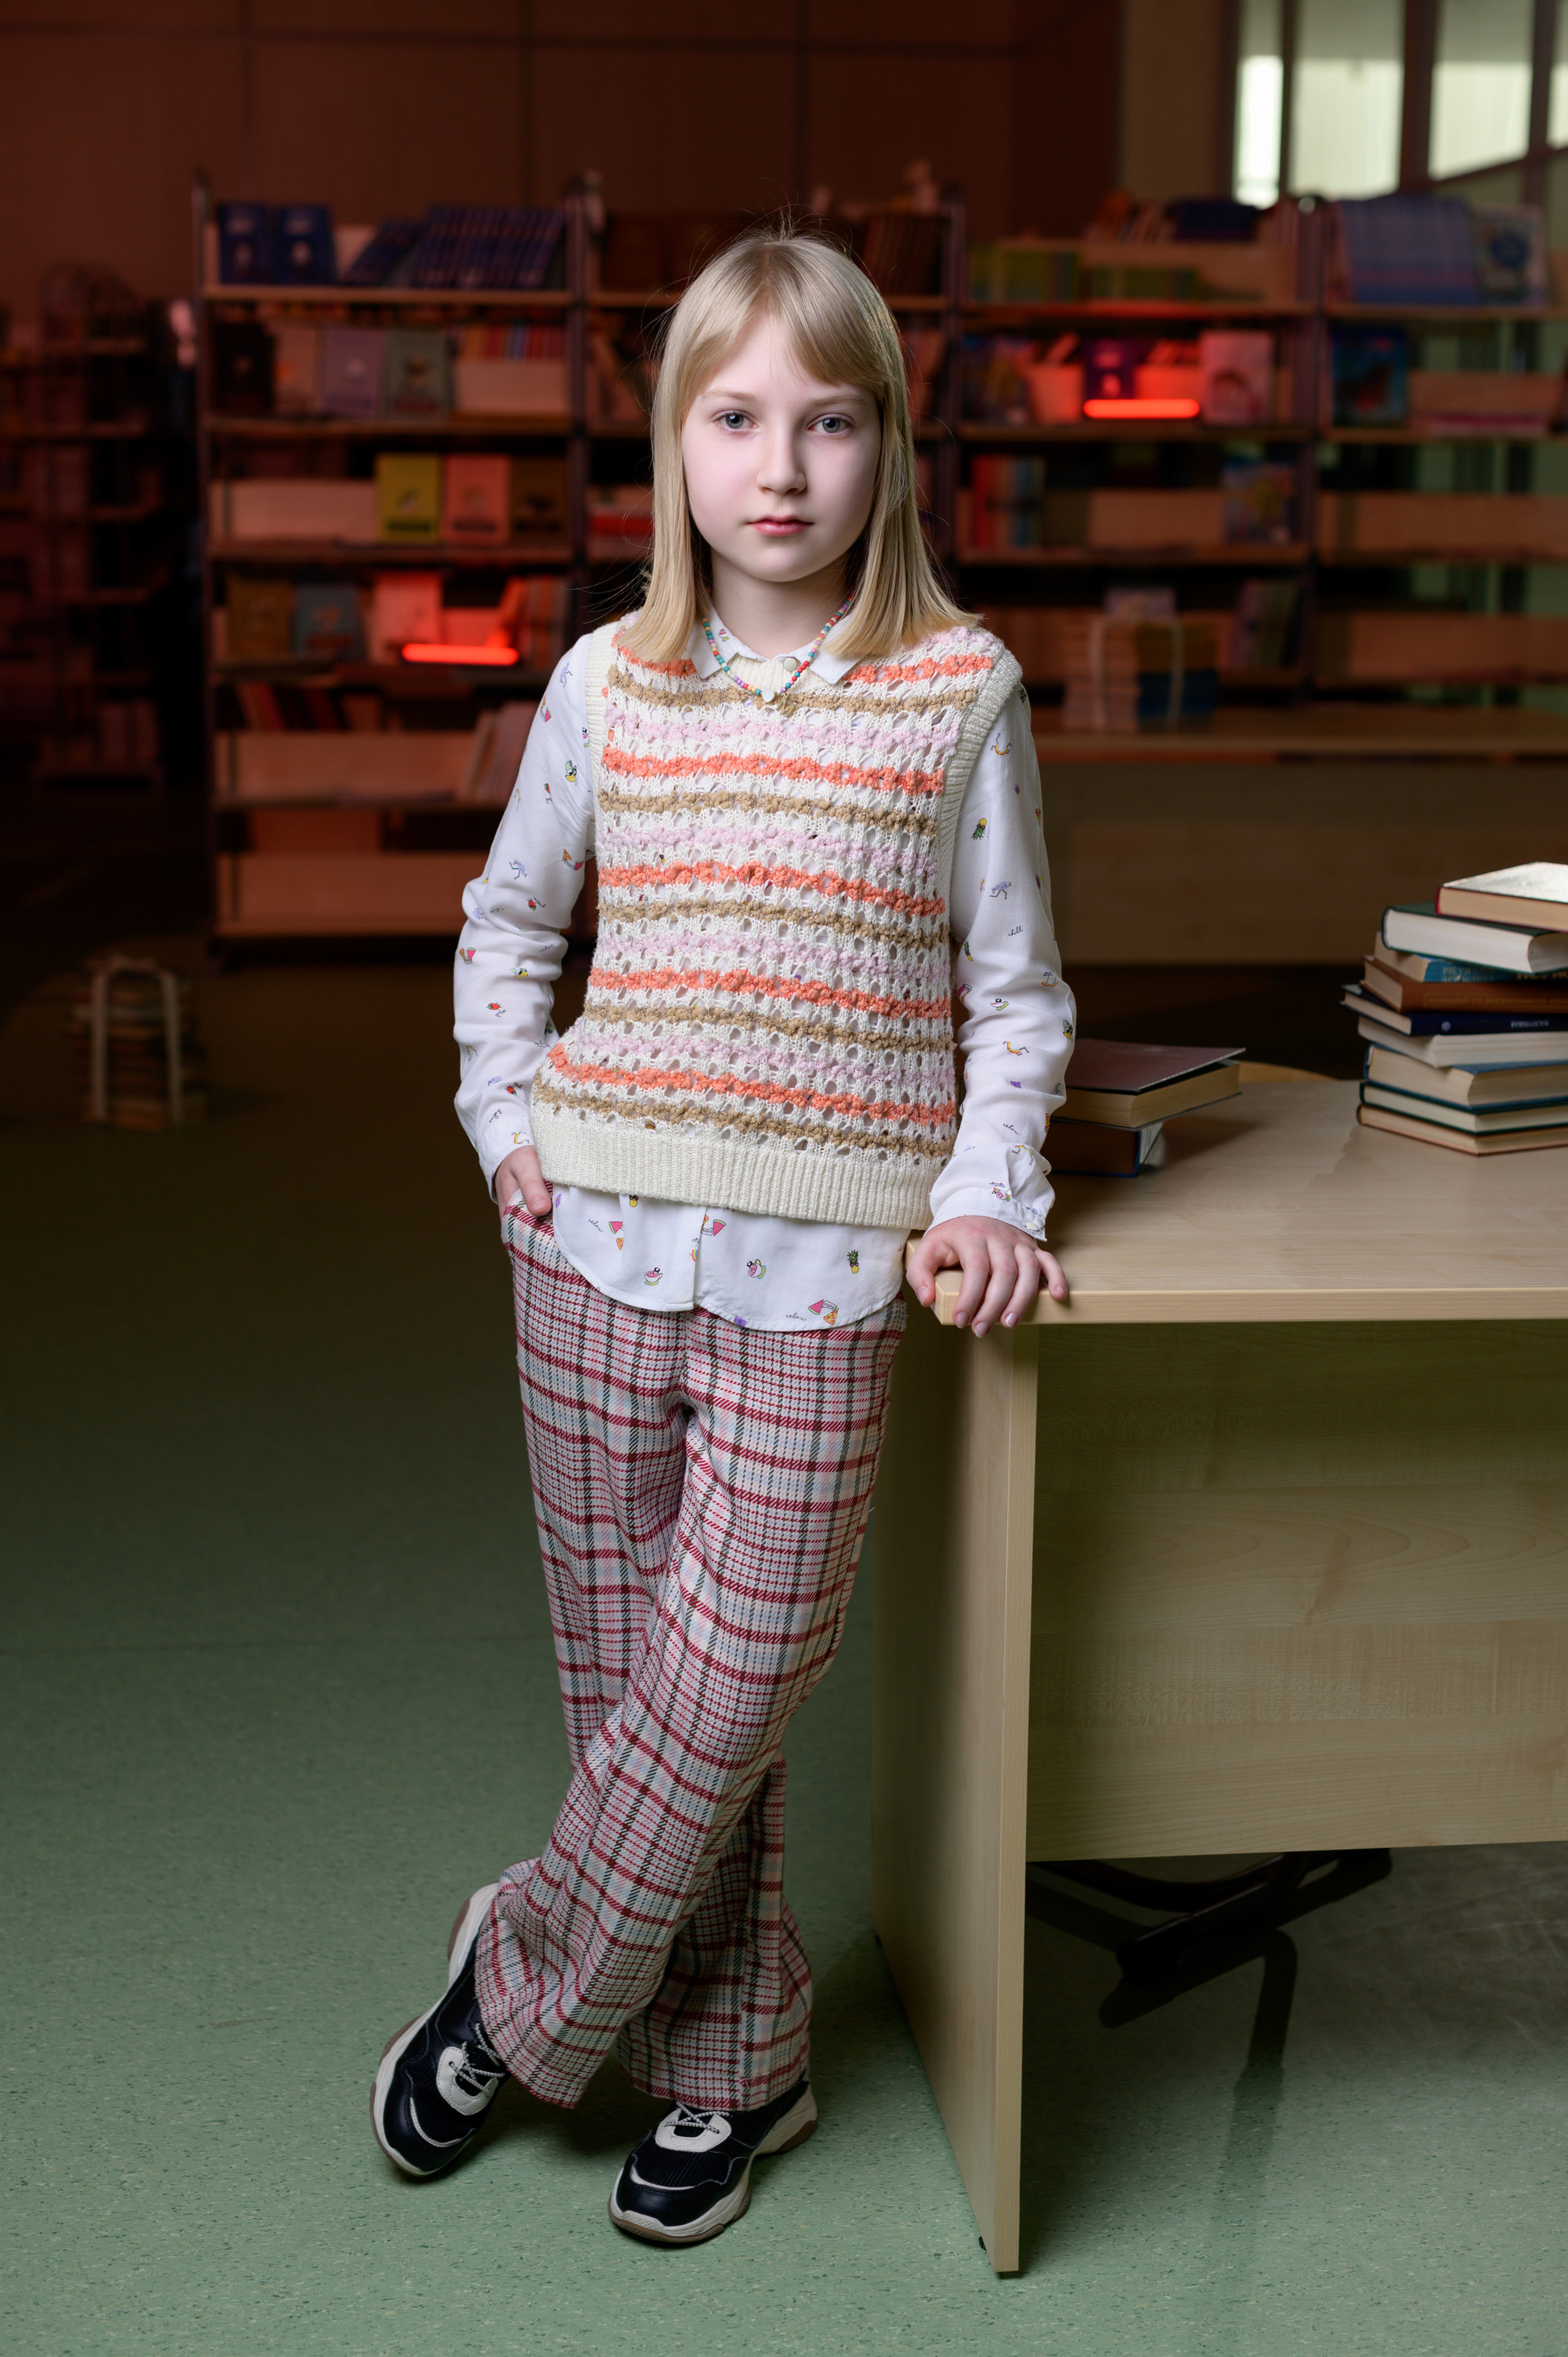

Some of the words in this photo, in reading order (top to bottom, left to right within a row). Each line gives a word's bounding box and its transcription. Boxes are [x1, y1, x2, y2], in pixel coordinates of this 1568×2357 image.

[775, 696, 796, 717] M
[1008, 925, 1023, 936] chill
[489, 1108, 502, 1123] enjoy
[1003, 1123, 1020, 1135] relax
[588, 1219, 603, 1233] relax
[786, 1312, 807, 1321] relax
